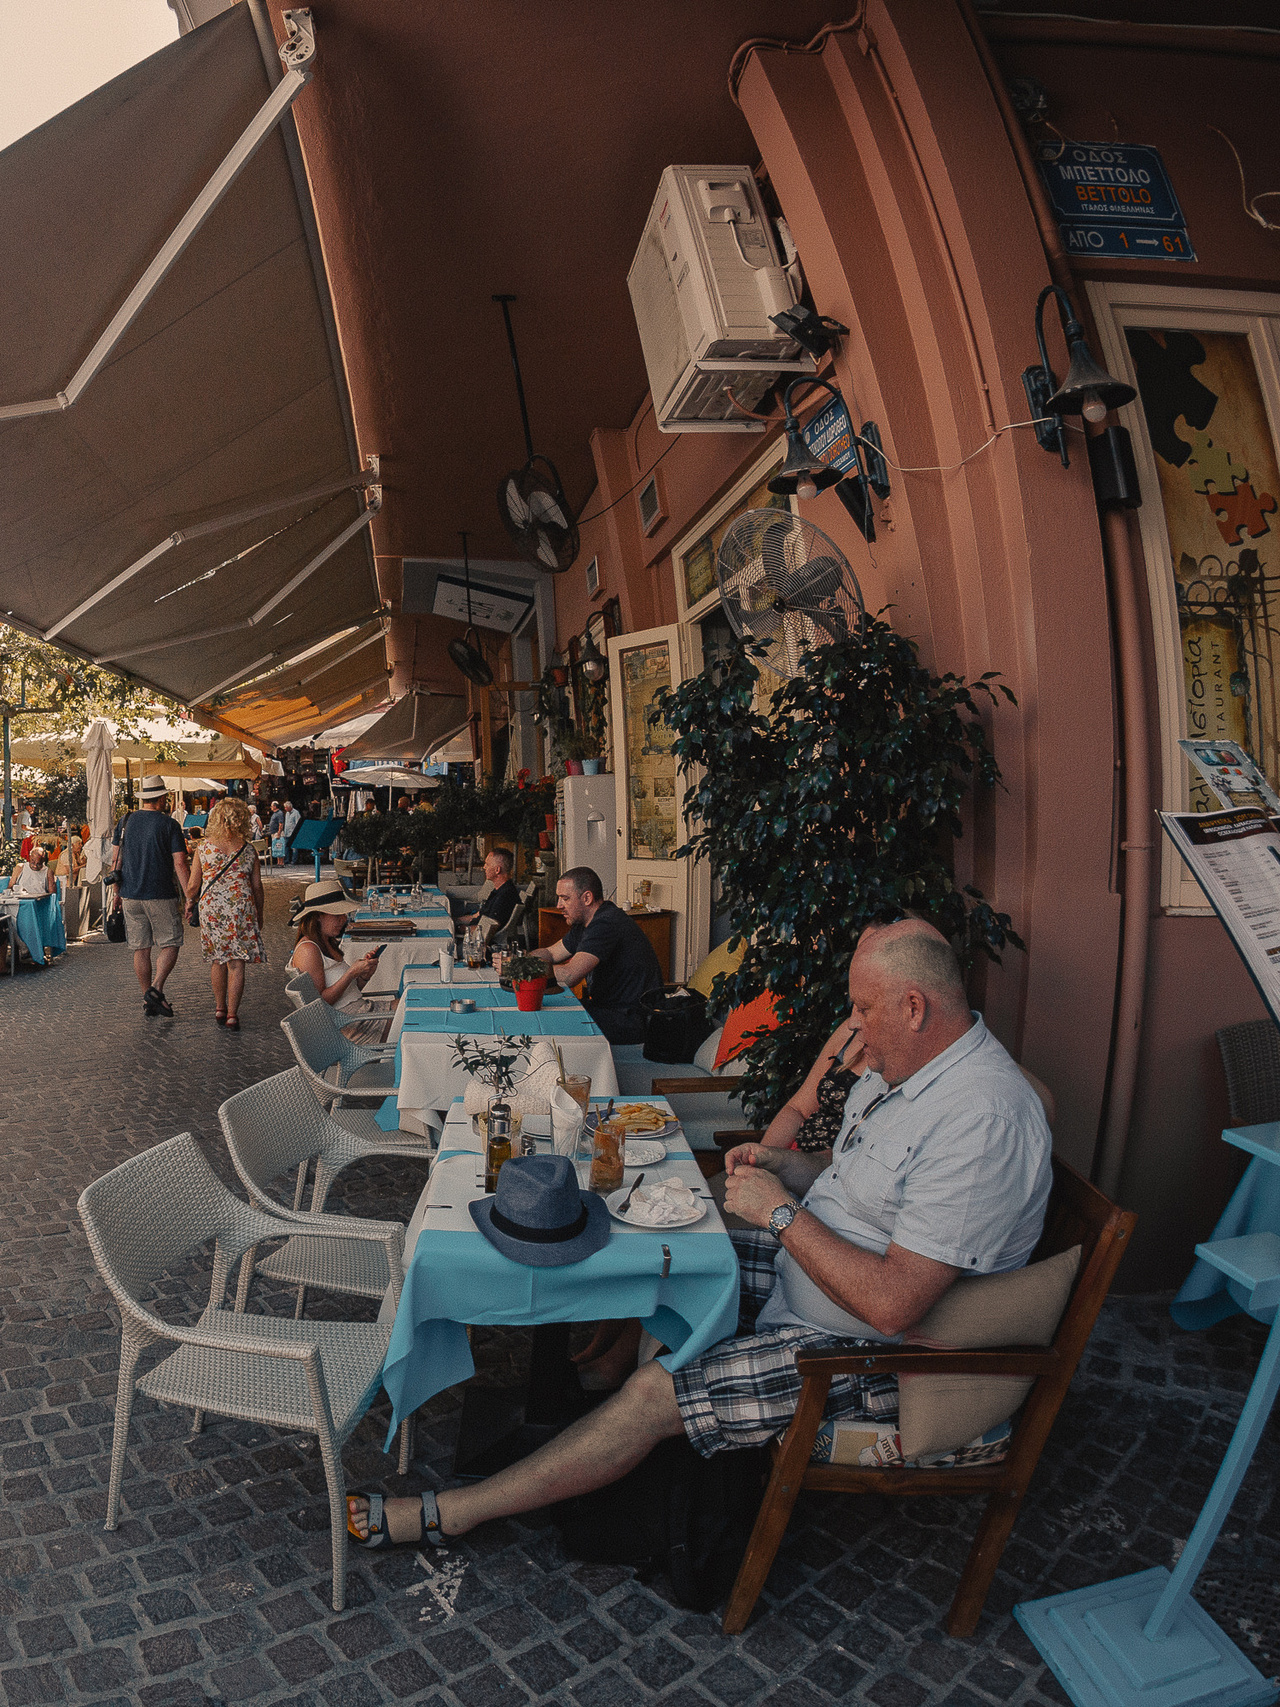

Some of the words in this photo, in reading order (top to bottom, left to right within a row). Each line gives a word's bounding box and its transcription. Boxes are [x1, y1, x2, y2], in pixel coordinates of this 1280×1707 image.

[1072, 149, 1128, 164] ΟΔΟΣ
[1058, 165, 1151, 184] ΜΠΕΤΤΟΛΟ
[1075, 185, 1152, 204] BETTOLO
[1069, 230, 1105, 248] ΑΠΟ
[1119, 232, 1129, 249] 1
[1162, 235, 1184, 253] 61
[814, 408, 835, 435] ΟΔΟΣ
[1210, 641, 1226, 734] TAURANT
